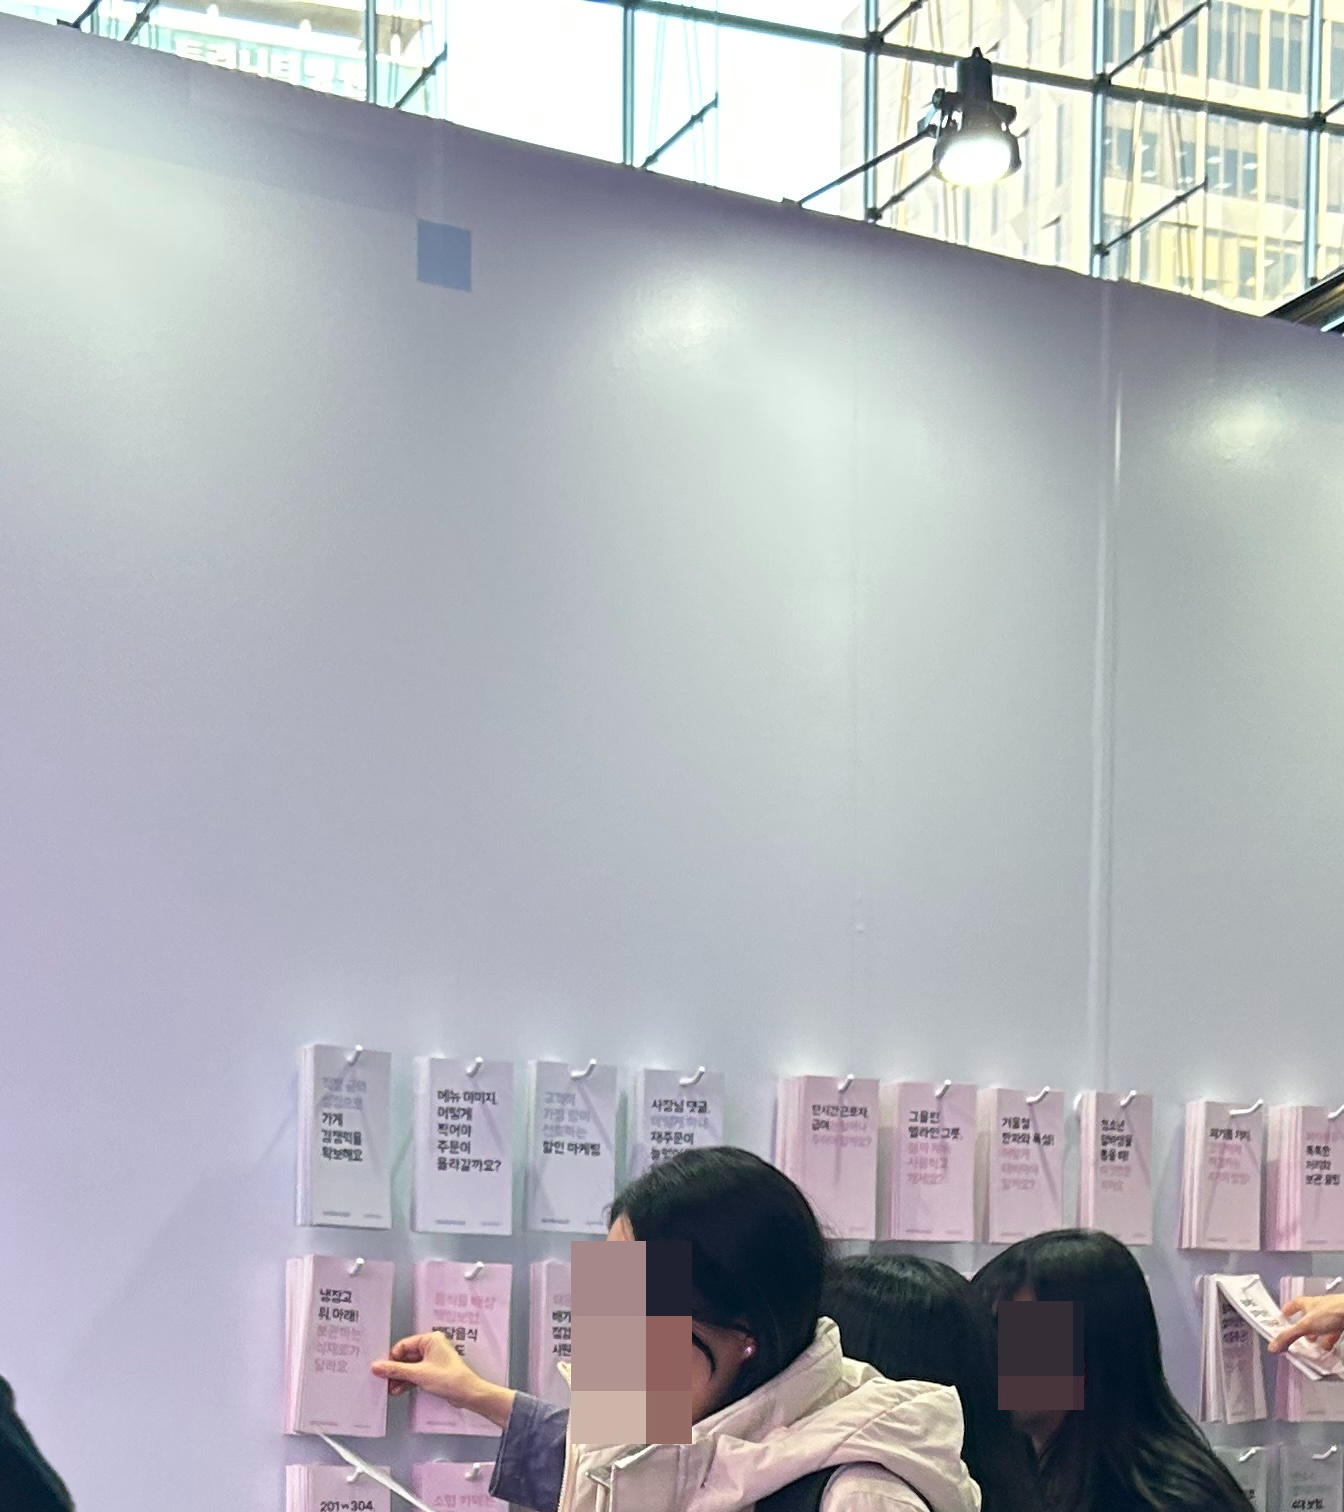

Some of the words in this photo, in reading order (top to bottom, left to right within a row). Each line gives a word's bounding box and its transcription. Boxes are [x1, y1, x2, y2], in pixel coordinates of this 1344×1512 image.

[437, 1089, 461, 1104] 메뉴
[437, 1107, 473, 1121] 어떻게
[651, 1099, 684, 1114] 사장님
[322, 1112, 343, 1127] 가게
[651, 1131, 694, 1146] 재주문이
[437, 1140, 471, 1155] 주문이
[543, 1140, 564, 1155] 할인
[567, 1142, 601, 1156] 마케팅
[437, 1157, 502, 1172] 올라갈까요?
[319, 1288, 353, 1303] 냉장고
